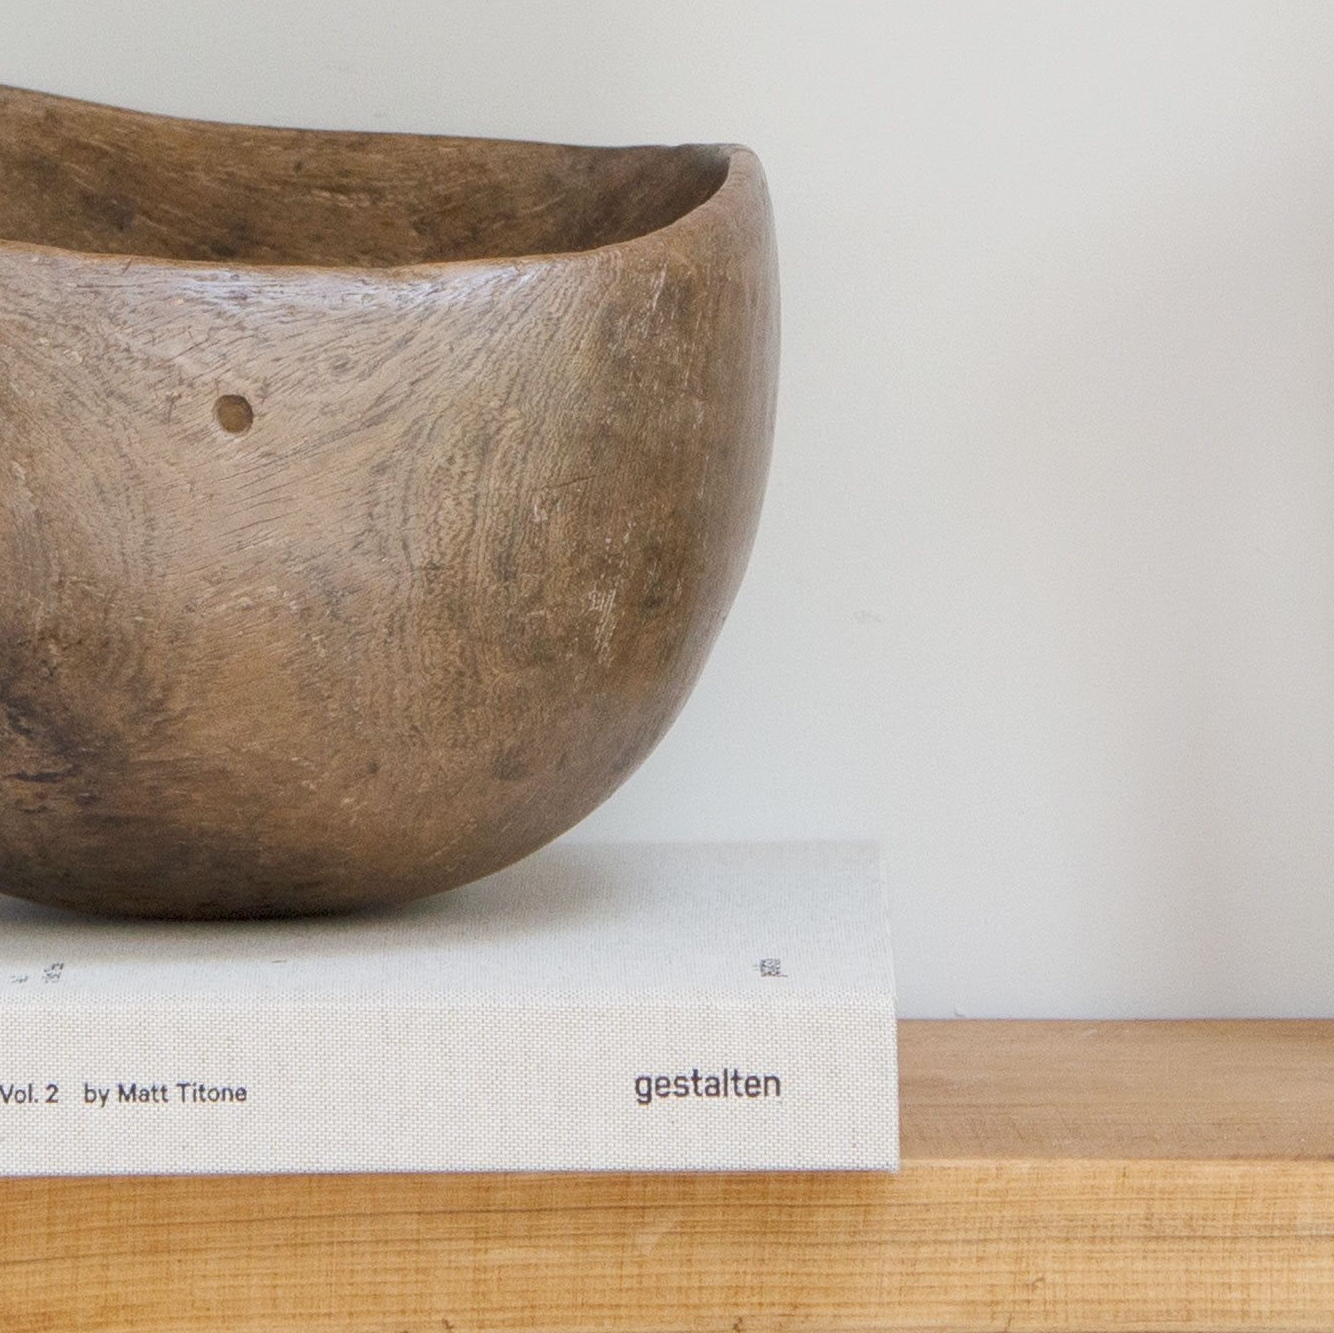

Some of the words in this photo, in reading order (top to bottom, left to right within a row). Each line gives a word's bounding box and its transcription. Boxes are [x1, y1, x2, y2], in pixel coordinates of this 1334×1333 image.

[44, 1082, 60, 1104] 2
[83, 1081, 111, 1108] by
[116, 1082, 170, 1104] Matt
[175, 1081, 248, 1104] Titone
[633, 1067, 782, 1107] gestalten
